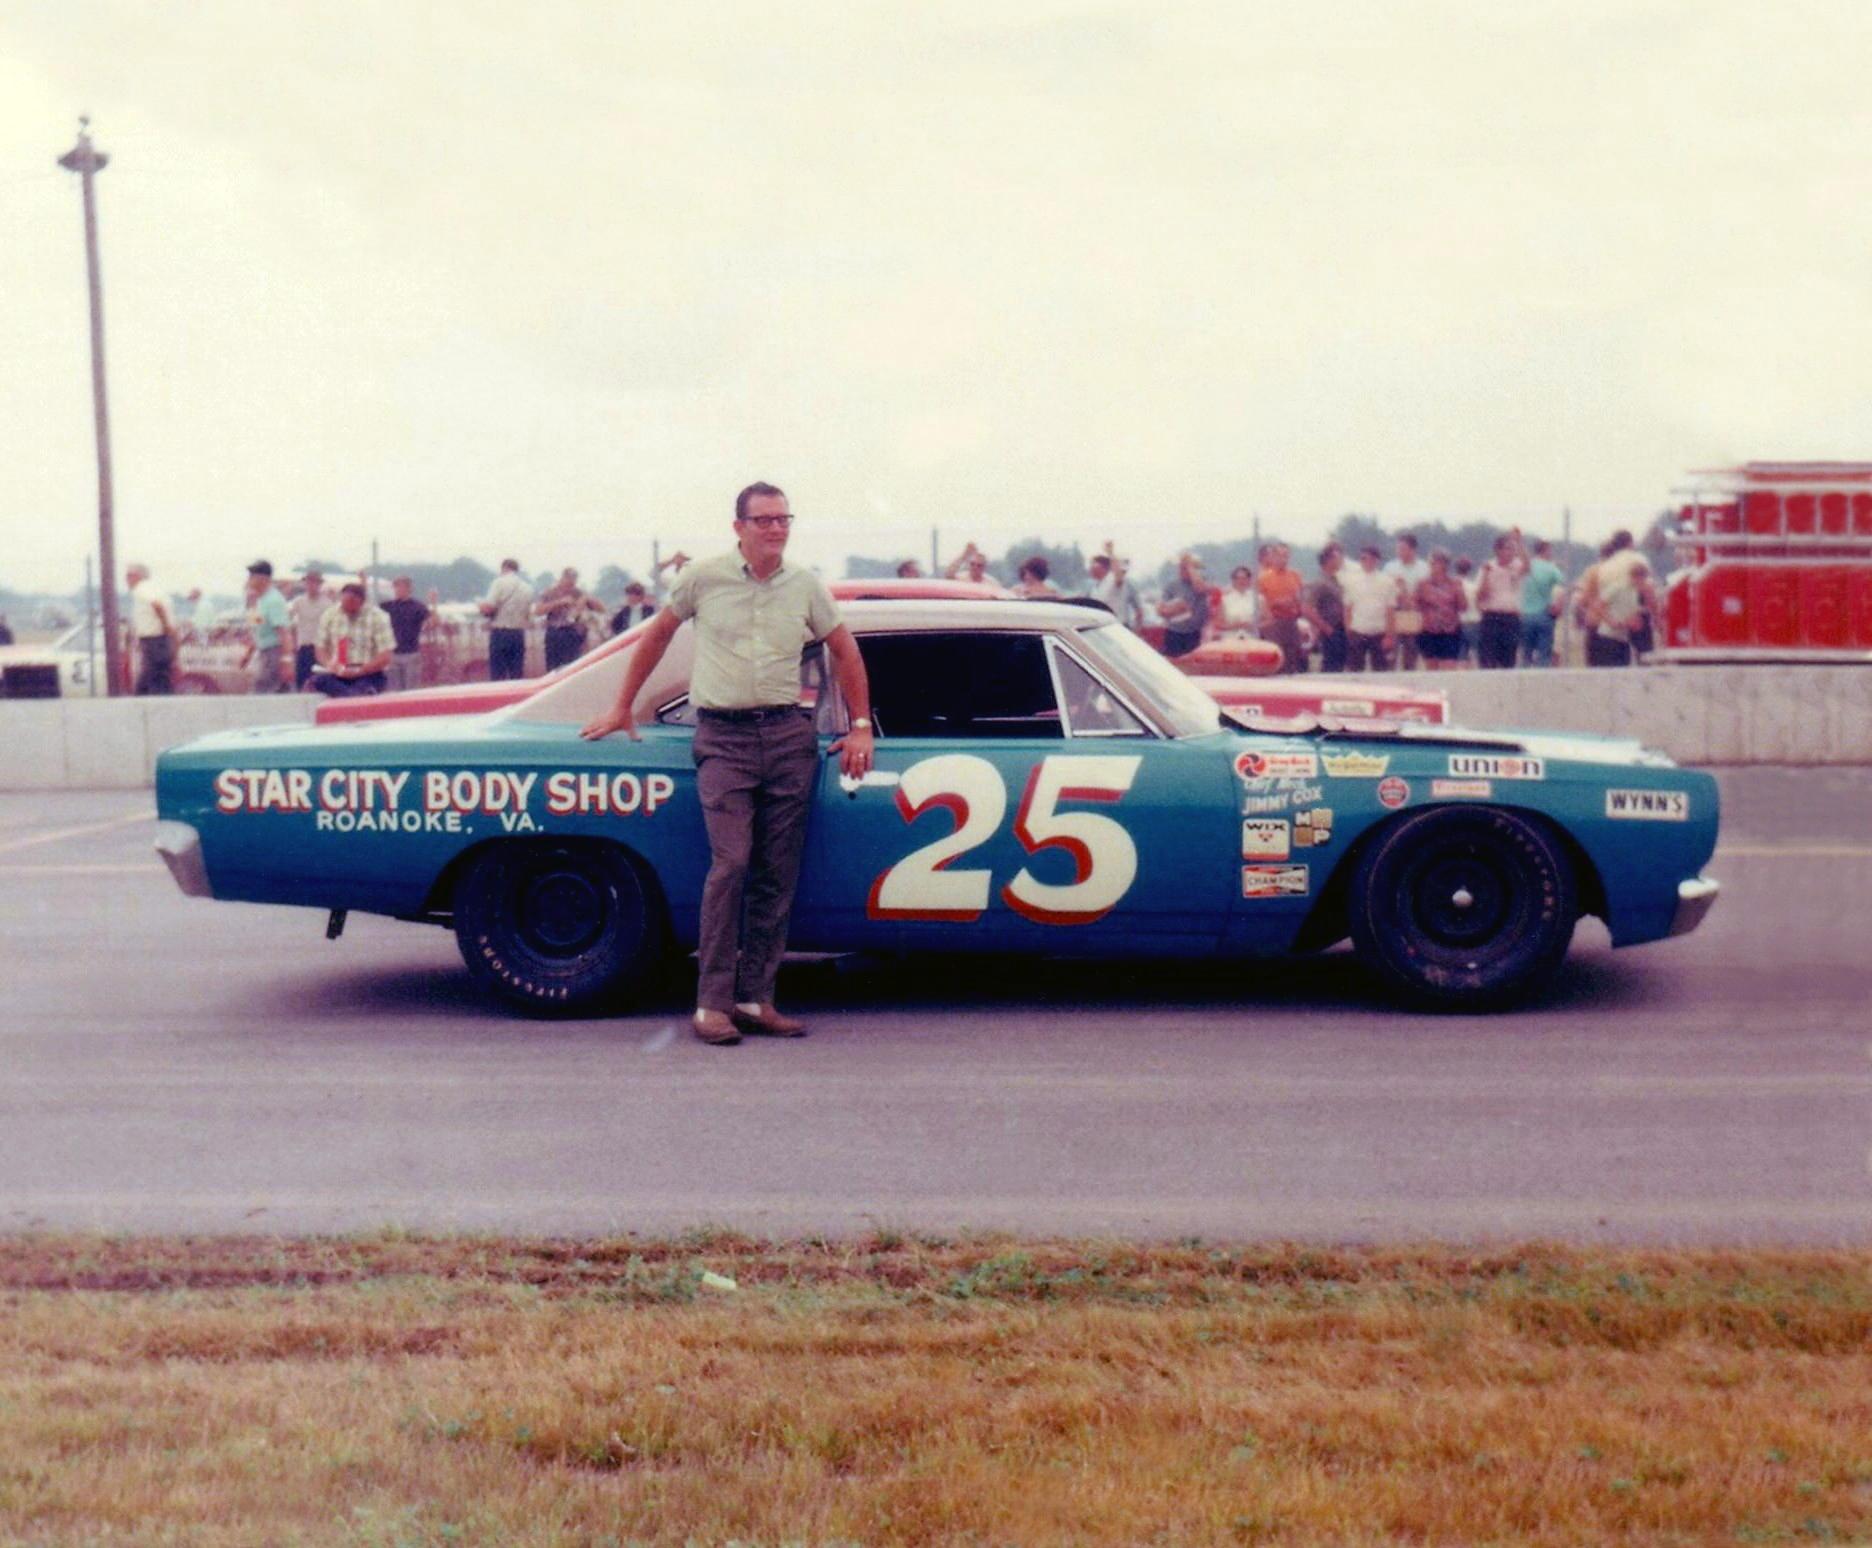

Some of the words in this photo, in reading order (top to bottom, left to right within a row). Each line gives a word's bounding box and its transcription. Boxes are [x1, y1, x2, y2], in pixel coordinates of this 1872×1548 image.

[215, 769, 312, 814] STAR
[319, 769, 410, 814] CITY
[422, 771, 538, 816] BODY
[545, 772, 675, 817] SHOP
[501, 811, 545, 833] VA.
[1246, 822, 1286, 831] WIX
[867, 754, 1144, 926] 25
[1247, 876, 1303, 886] CHAMPION
